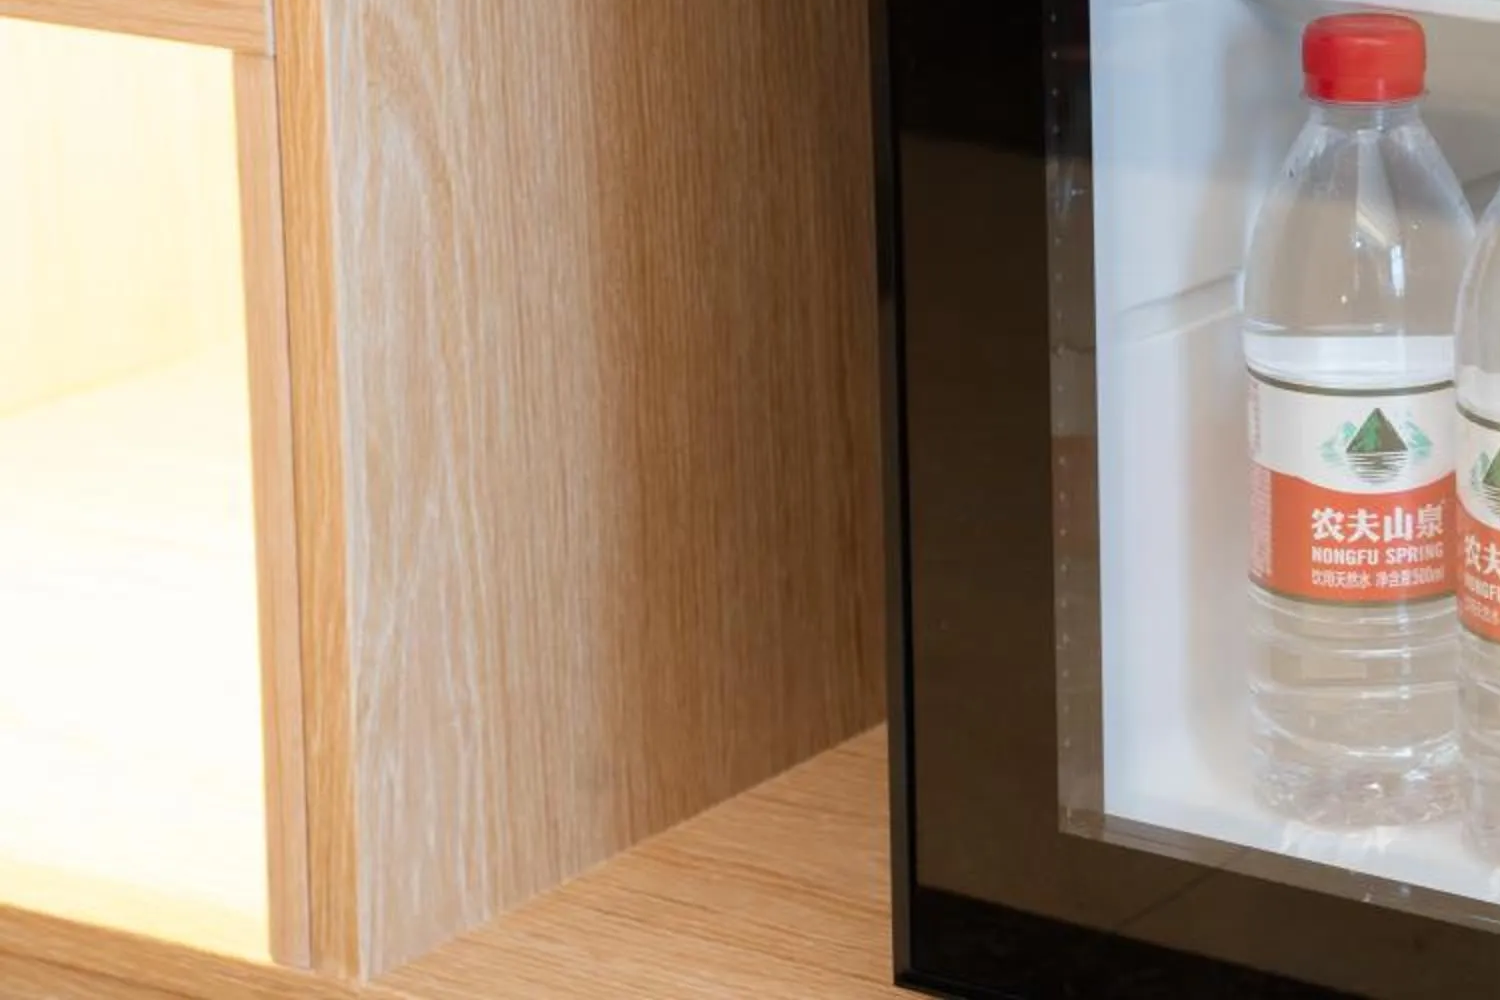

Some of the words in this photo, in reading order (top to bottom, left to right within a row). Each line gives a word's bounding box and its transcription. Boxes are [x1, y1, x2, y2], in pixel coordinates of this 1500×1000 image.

[1311, 503, 1444, 543] 农夫山泉
[1311, 546, 1379, 566] NONGFU
[1384, 541, 1444, 565] SPRING
